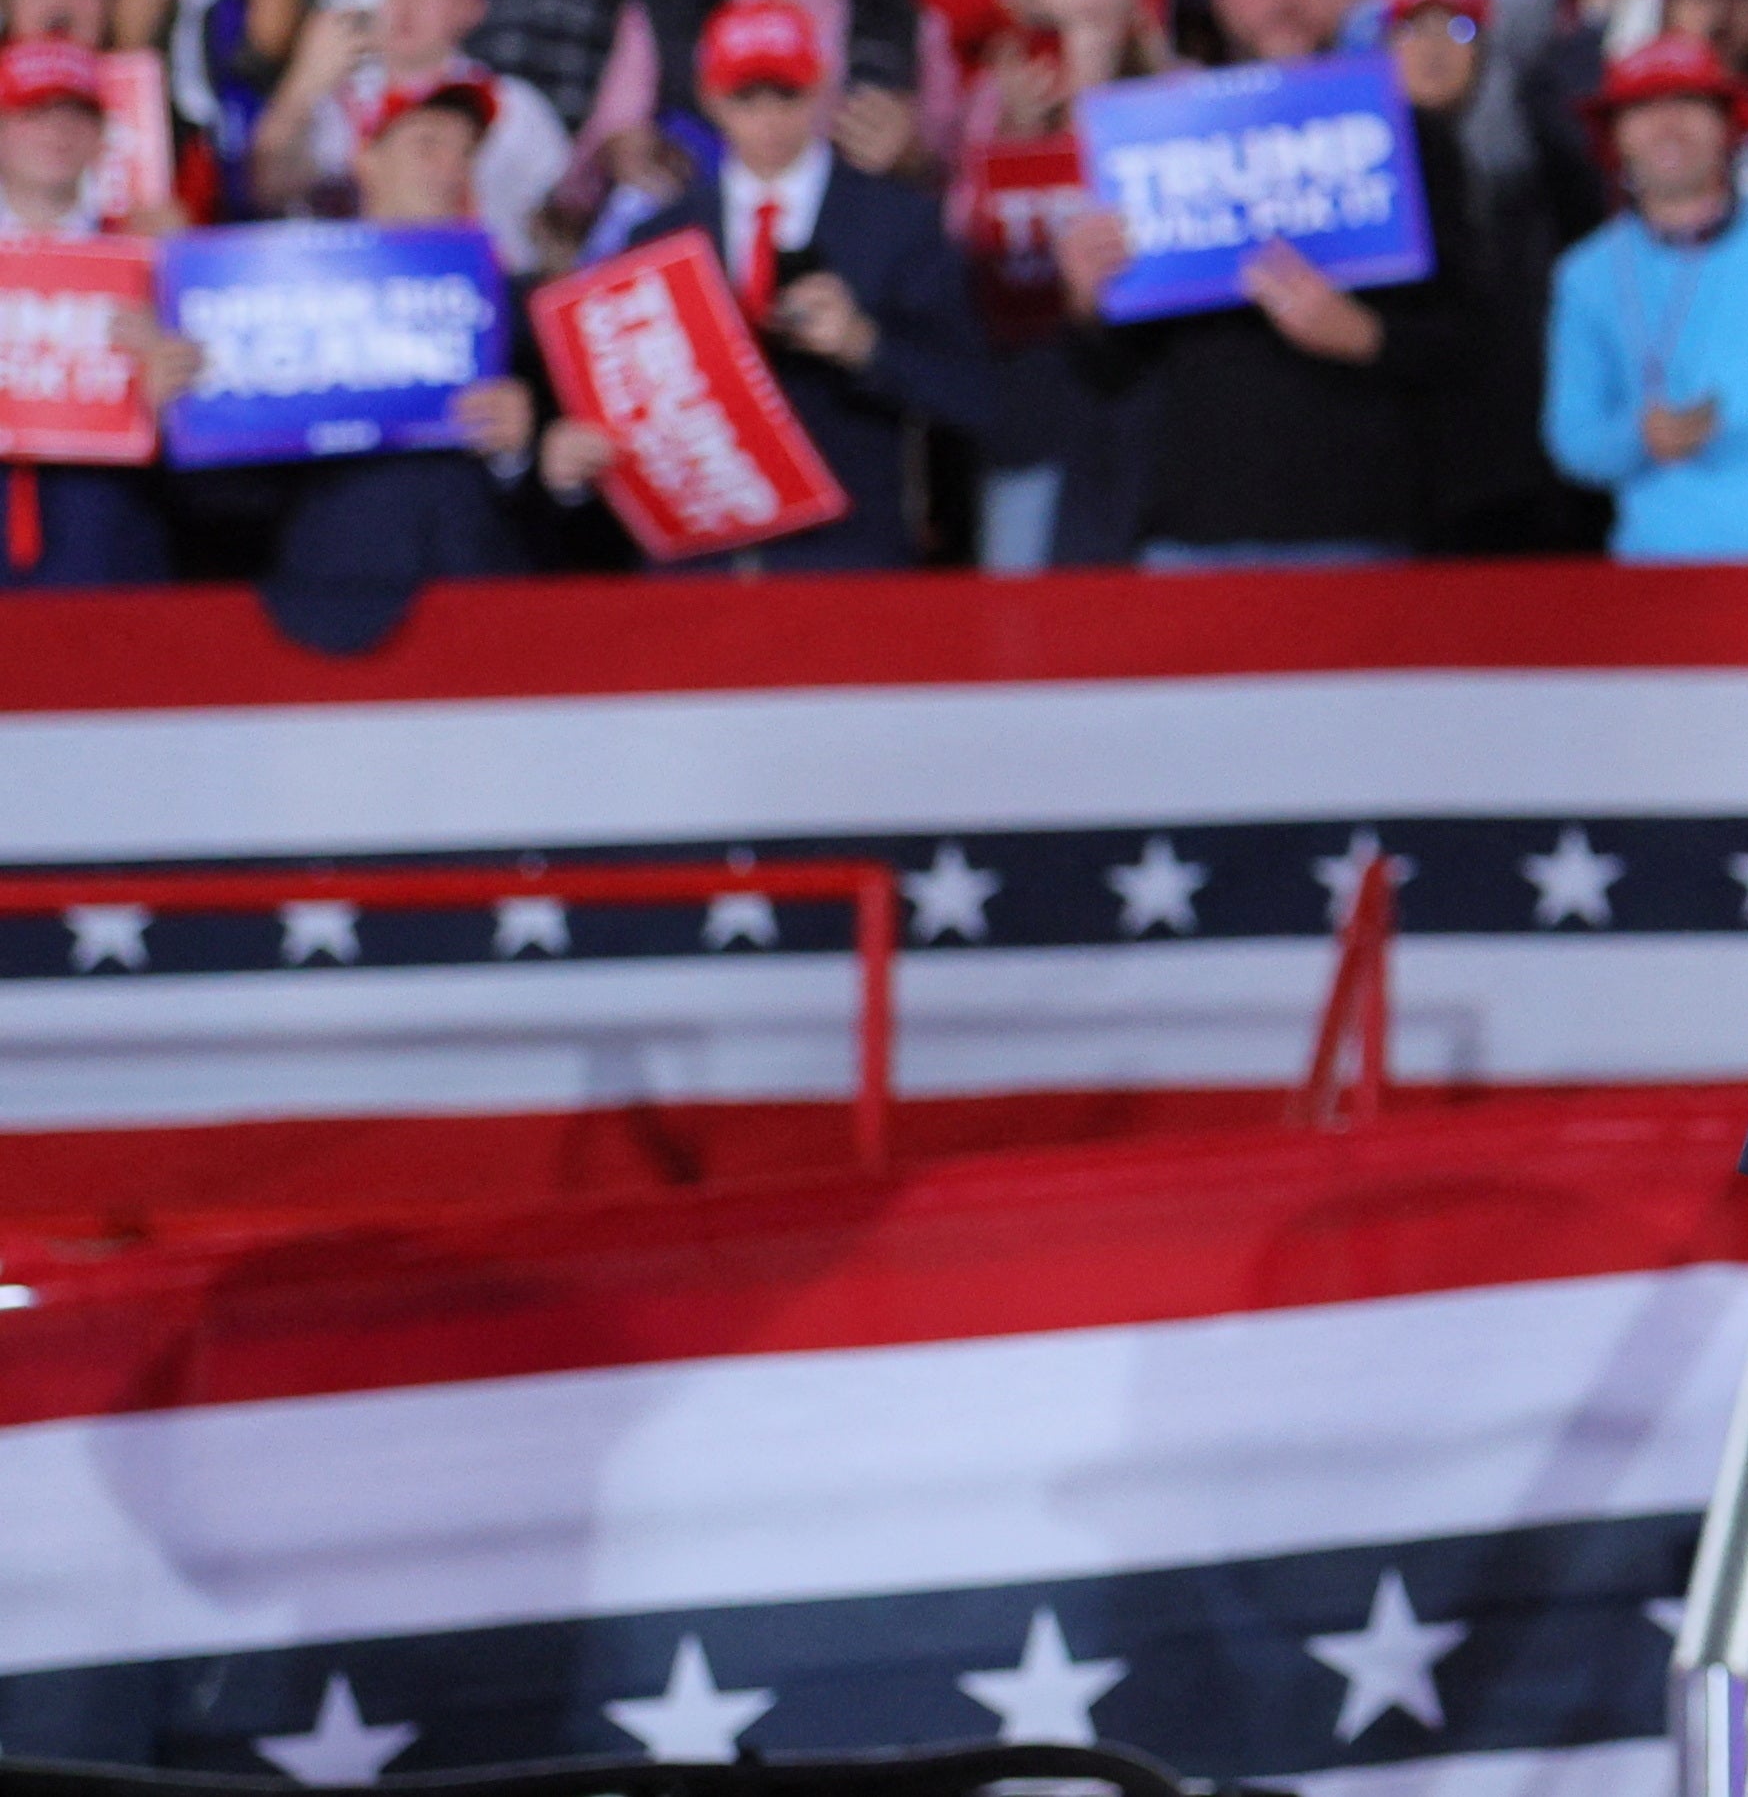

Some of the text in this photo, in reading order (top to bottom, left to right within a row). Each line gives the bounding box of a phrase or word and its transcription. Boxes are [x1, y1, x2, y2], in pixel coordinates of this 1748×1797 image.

[1104, 111, 1395, 221] TRUMP
[1126, 206, 1250, 259] WILL
[1250, 189, 1338, 243] FIX
[1338, 169, 1399, 230] IT
[178, 279, 376, 341] DREAM
[380, 271, 497, 333] BIG,
[190, 323, 479, 401] AGAIN!
[605, 265, 781, 527] TRUMP
